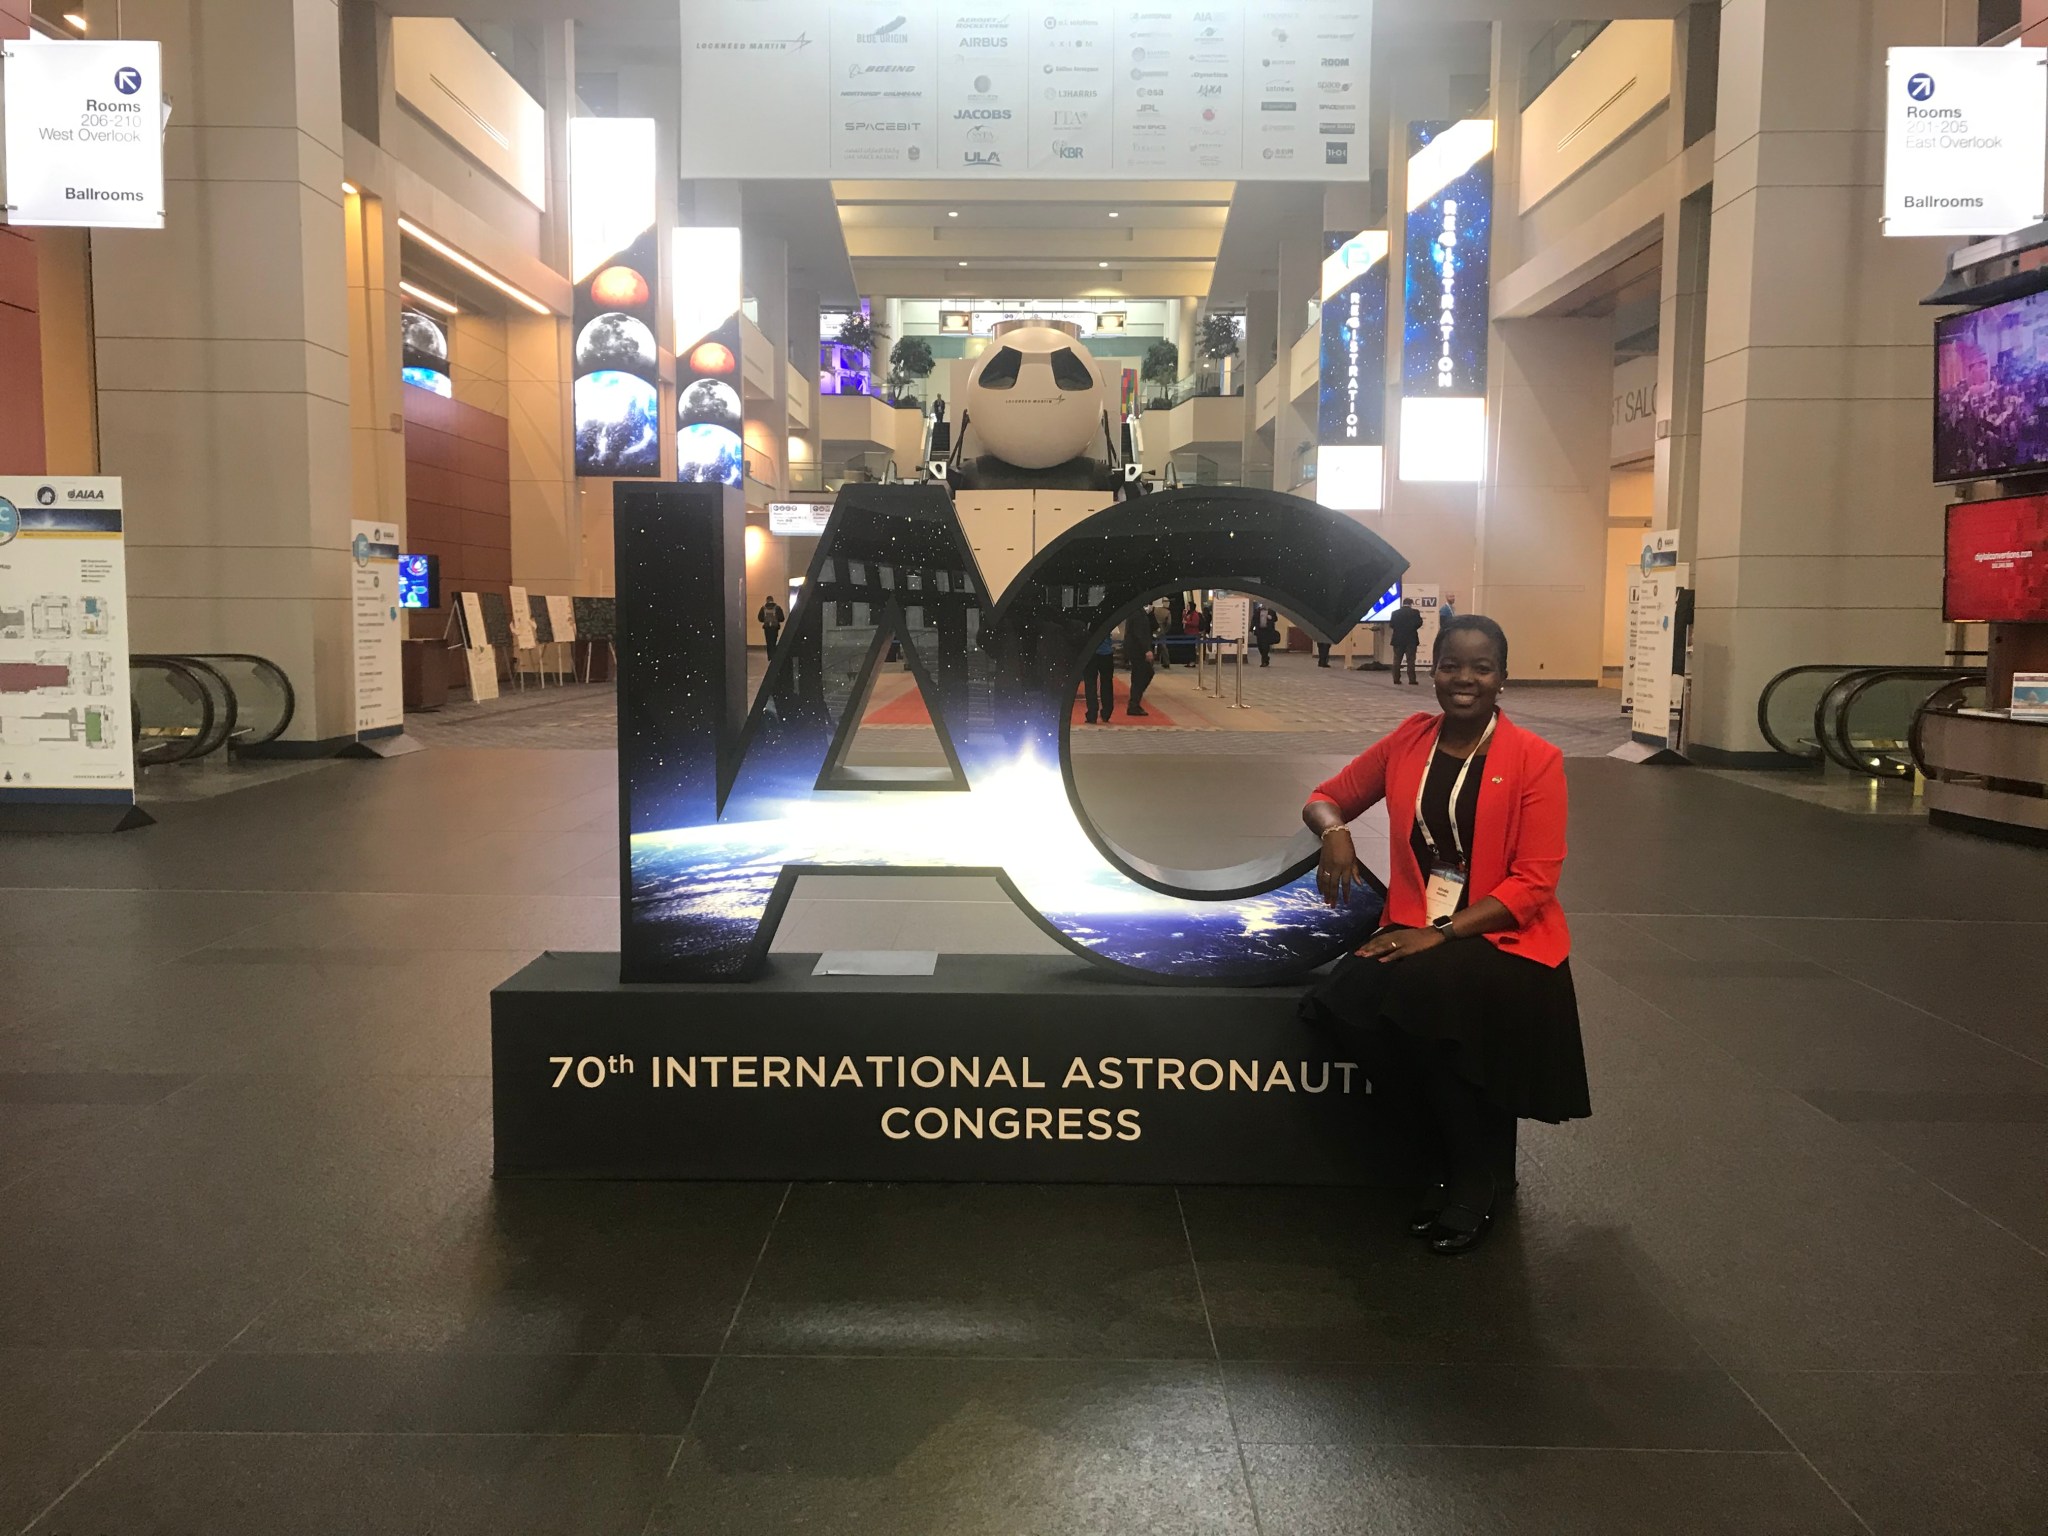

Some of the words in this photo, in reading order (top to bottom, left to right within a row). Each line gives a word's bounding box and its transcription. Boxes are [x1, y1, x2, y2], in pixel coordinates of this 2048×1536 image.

[856, 33, 878, 44] BLUE
[879, 33, 908, 44] ORIGIN
[959, 37, 1009, 48] AIRBUS
[696, 42, 745, 50] LOCKHEED
[749, 42, 786, 50] MARTIN
[1321, 58, 1350, 67] ROOM
[865, 65, 917, 73] BOEING
[1197, 84, 1223, 97] JAXA
[1317, 81, 1341, 90] space
[1146, 87, 1164, 97] esa
[86, 99, 141, 112] Rooms
[953, 109, 1012, 120] JACOBS
[1907, 106, 1962, 119] Rooms
[81, 113, 142, 128] 206-210
[844, 122, 921, 131] SPACEBIT
[1906, 120, 1968, 134] 201-205
[39, 127, 74, 141] West
[78, 128, 141, 142] Overlook
[1906, 135, 1936, 149] East
[1939, 135, 2002, 149] Overlook
[964, 151, 1001, 162] ULA
[1059, 147, 1084, 159] KBR
[65, 187, 144, 202] Ballrooms
[1904, 195, 1984, 208] Ballrooms
[1437, 199, 1457, 388] REGISTRATION
[1345, 292, 1361, 438] REGISTRATION
[75, 489, 104, 499] AIAA
[1423, 598, 1436, 606] TV
[550, 1054, 635, 1089] 70th
[652, 1055, 1046, 1089] INTERNATIONAL
[880, 1106, 1143, 1142] CONGRESS
